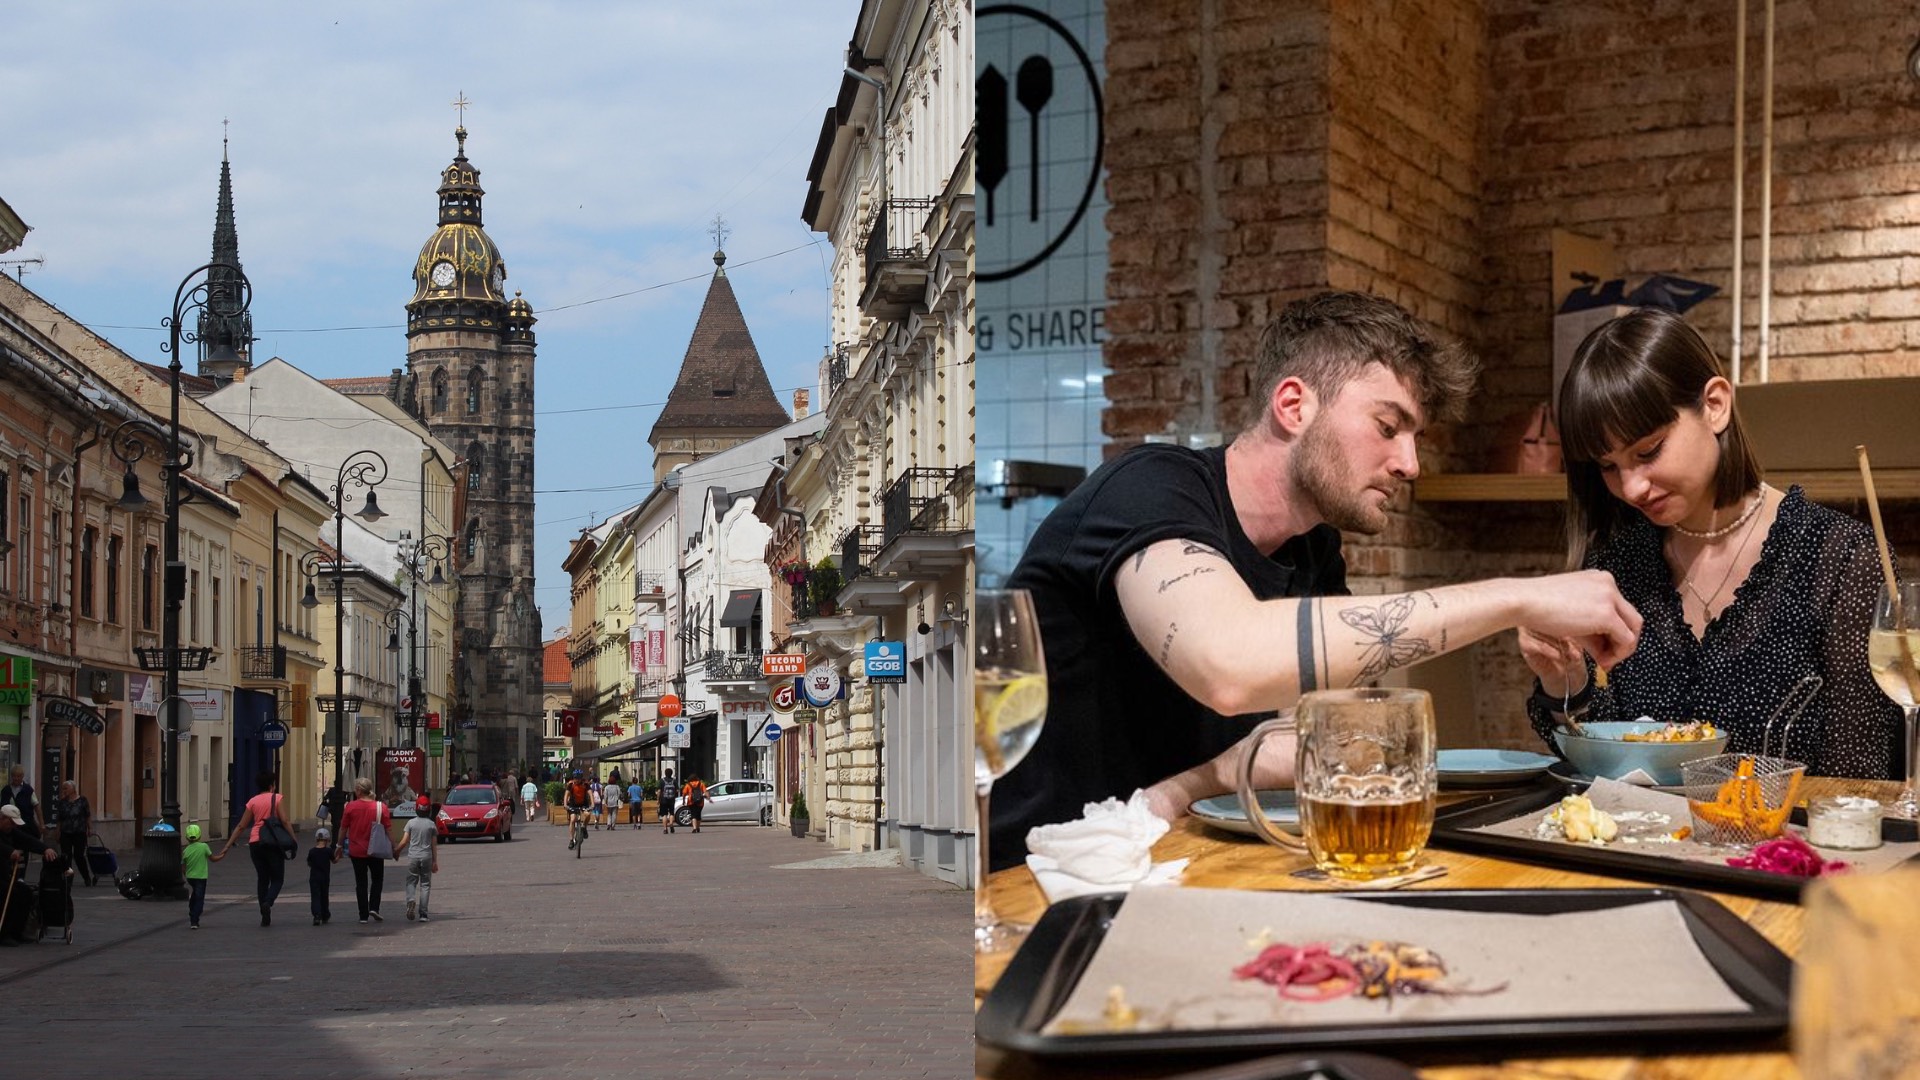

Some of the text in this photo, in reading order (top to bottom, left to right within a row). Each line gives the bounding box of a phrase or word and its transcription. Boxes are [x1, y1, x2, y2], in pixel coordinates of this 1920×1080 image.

[976, 308, 1106, 351] & SHARE
[765, 656, 803, 665] SECOND
[868, 660, 901, 671] ČSOB
[722, 701, 766, 716] primi
[55, 703, 101, 731] BICYKLE
